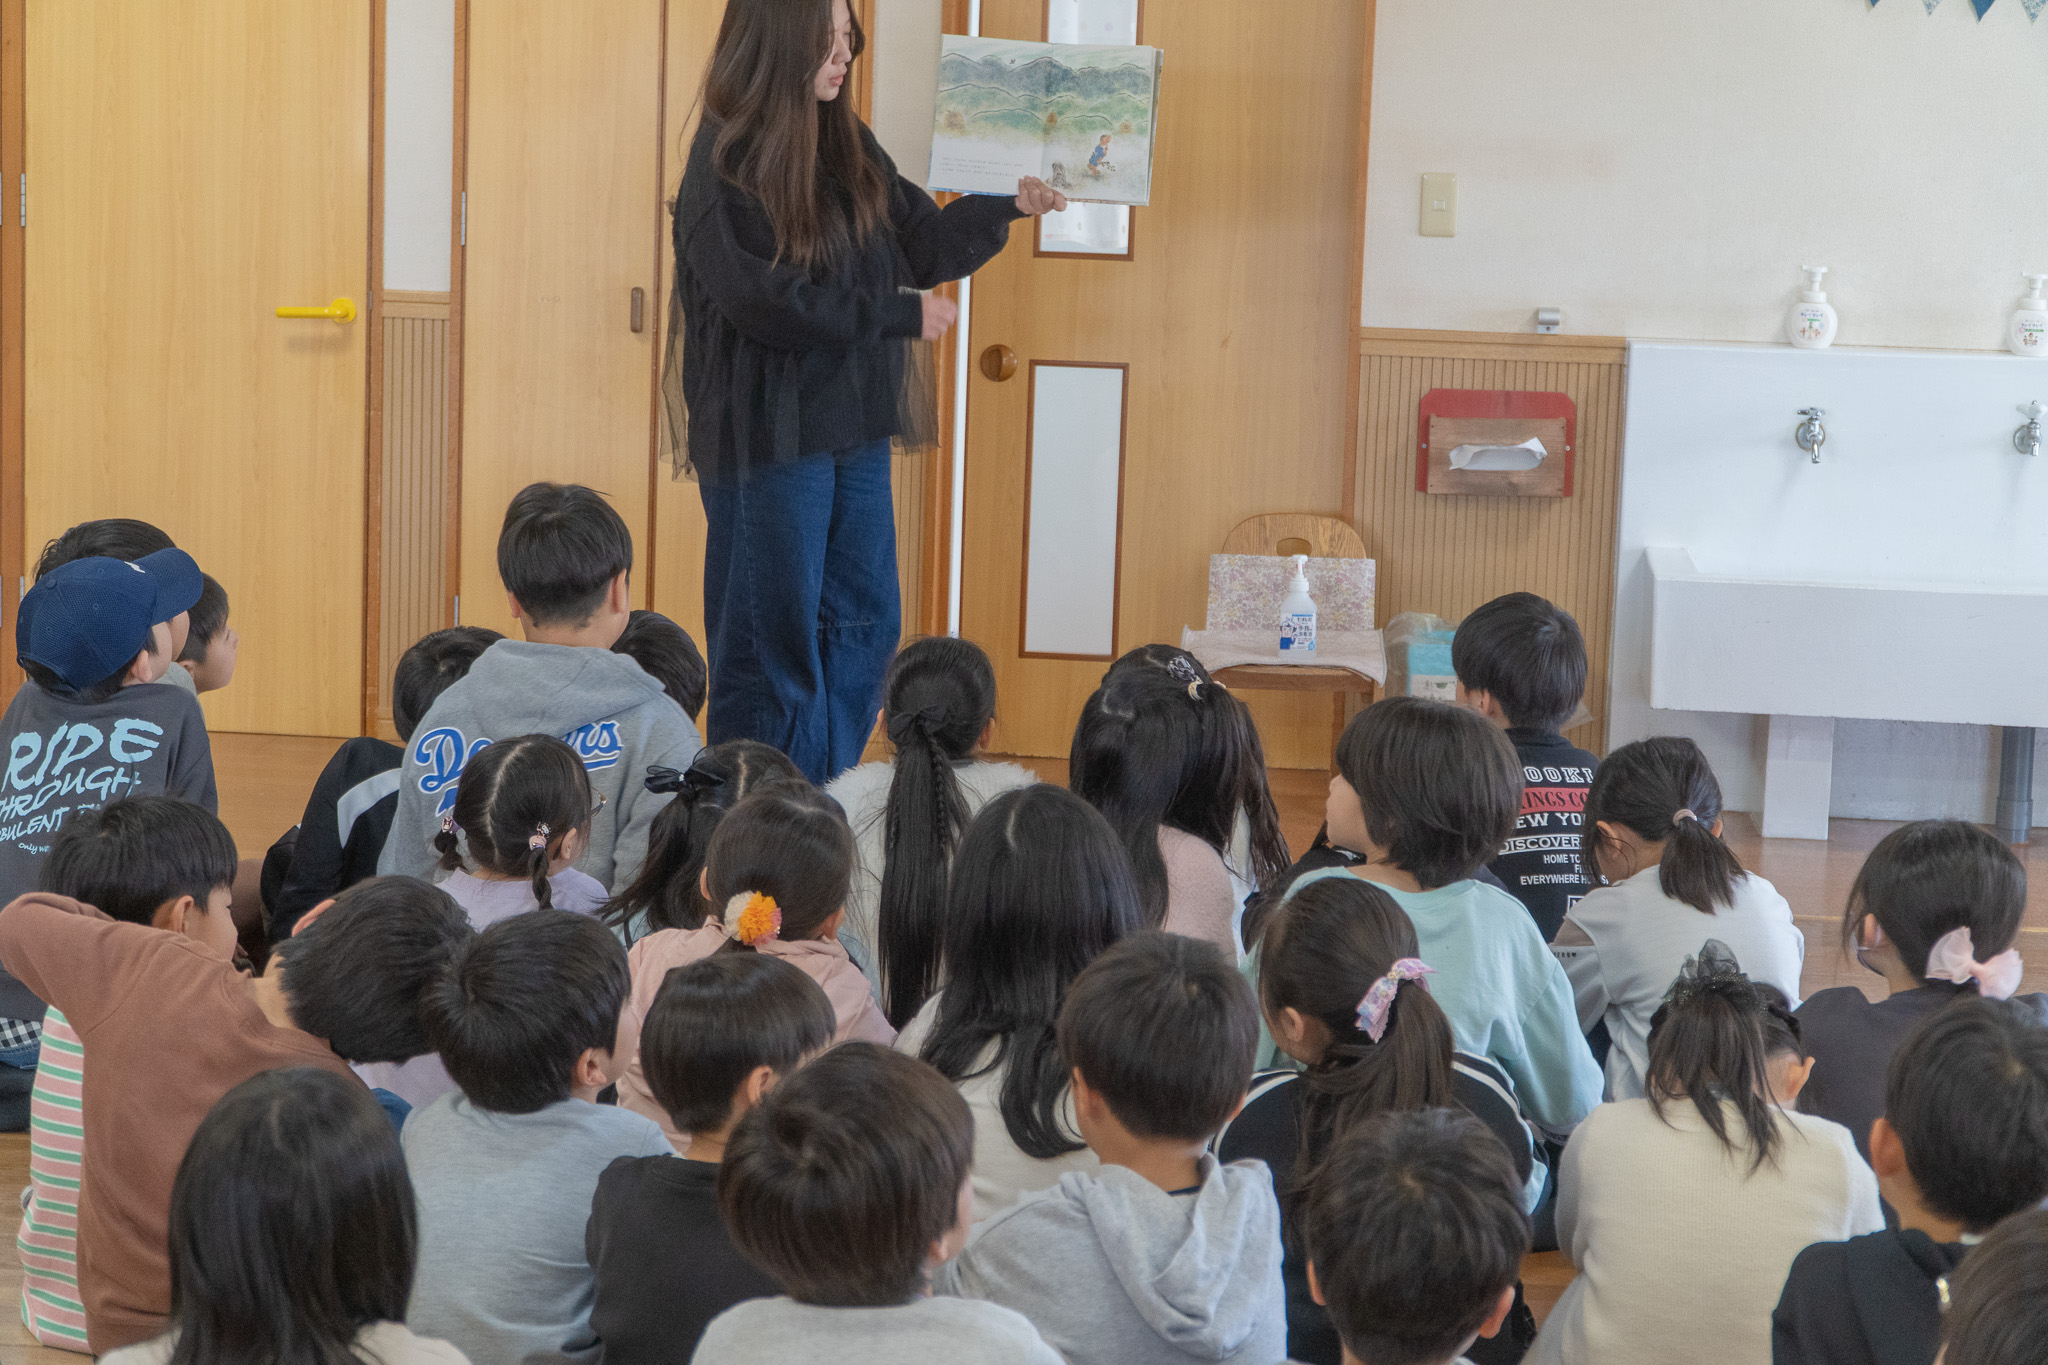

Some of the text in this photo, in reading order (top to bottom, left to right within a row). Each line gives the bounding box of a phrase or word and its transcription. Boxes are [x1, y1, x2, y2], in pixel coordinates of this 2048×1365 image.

[1, 718, 164, 792] RIDE
[18, 843, 38, 855] Only
[1543, 854, 1569, 864] HOME
[1520, 875, 1580, 886] EVERYWHERE
